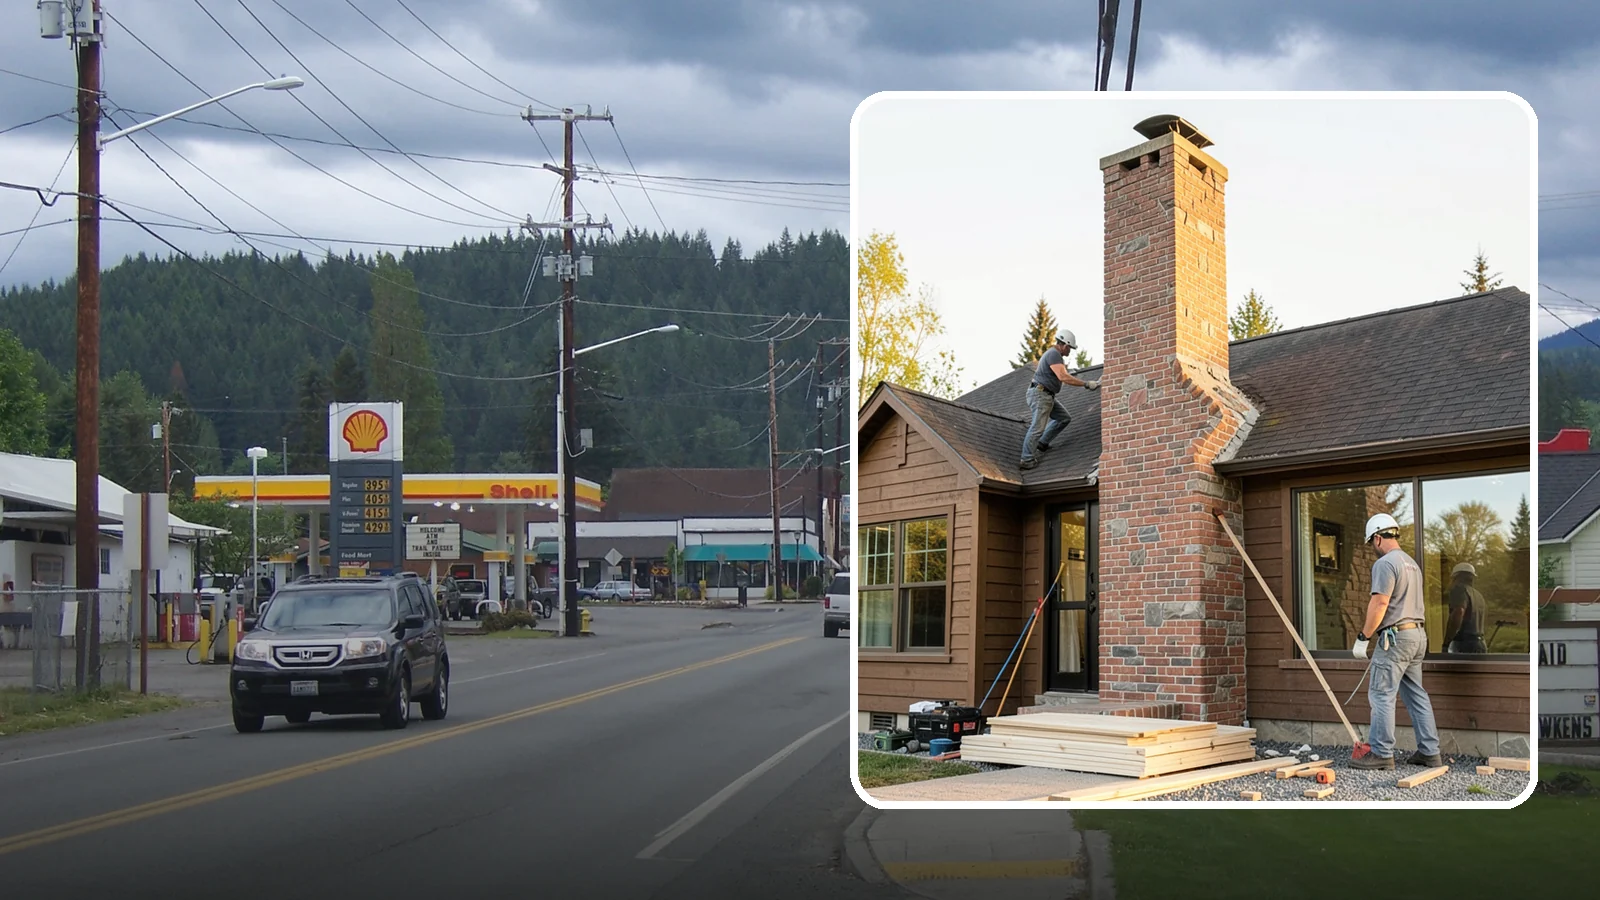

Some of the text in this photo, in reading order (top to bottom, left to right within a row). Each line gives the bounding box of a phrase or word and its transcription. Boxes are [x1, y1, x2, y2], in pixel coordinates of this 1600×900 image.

[366, 480, 383, 490] 395
[490, 484, 547, 499] Shell
[366, 494, 383, 504] 405
[366, 508, 383, 518] 415
[366, 522, 383, 532] 429
